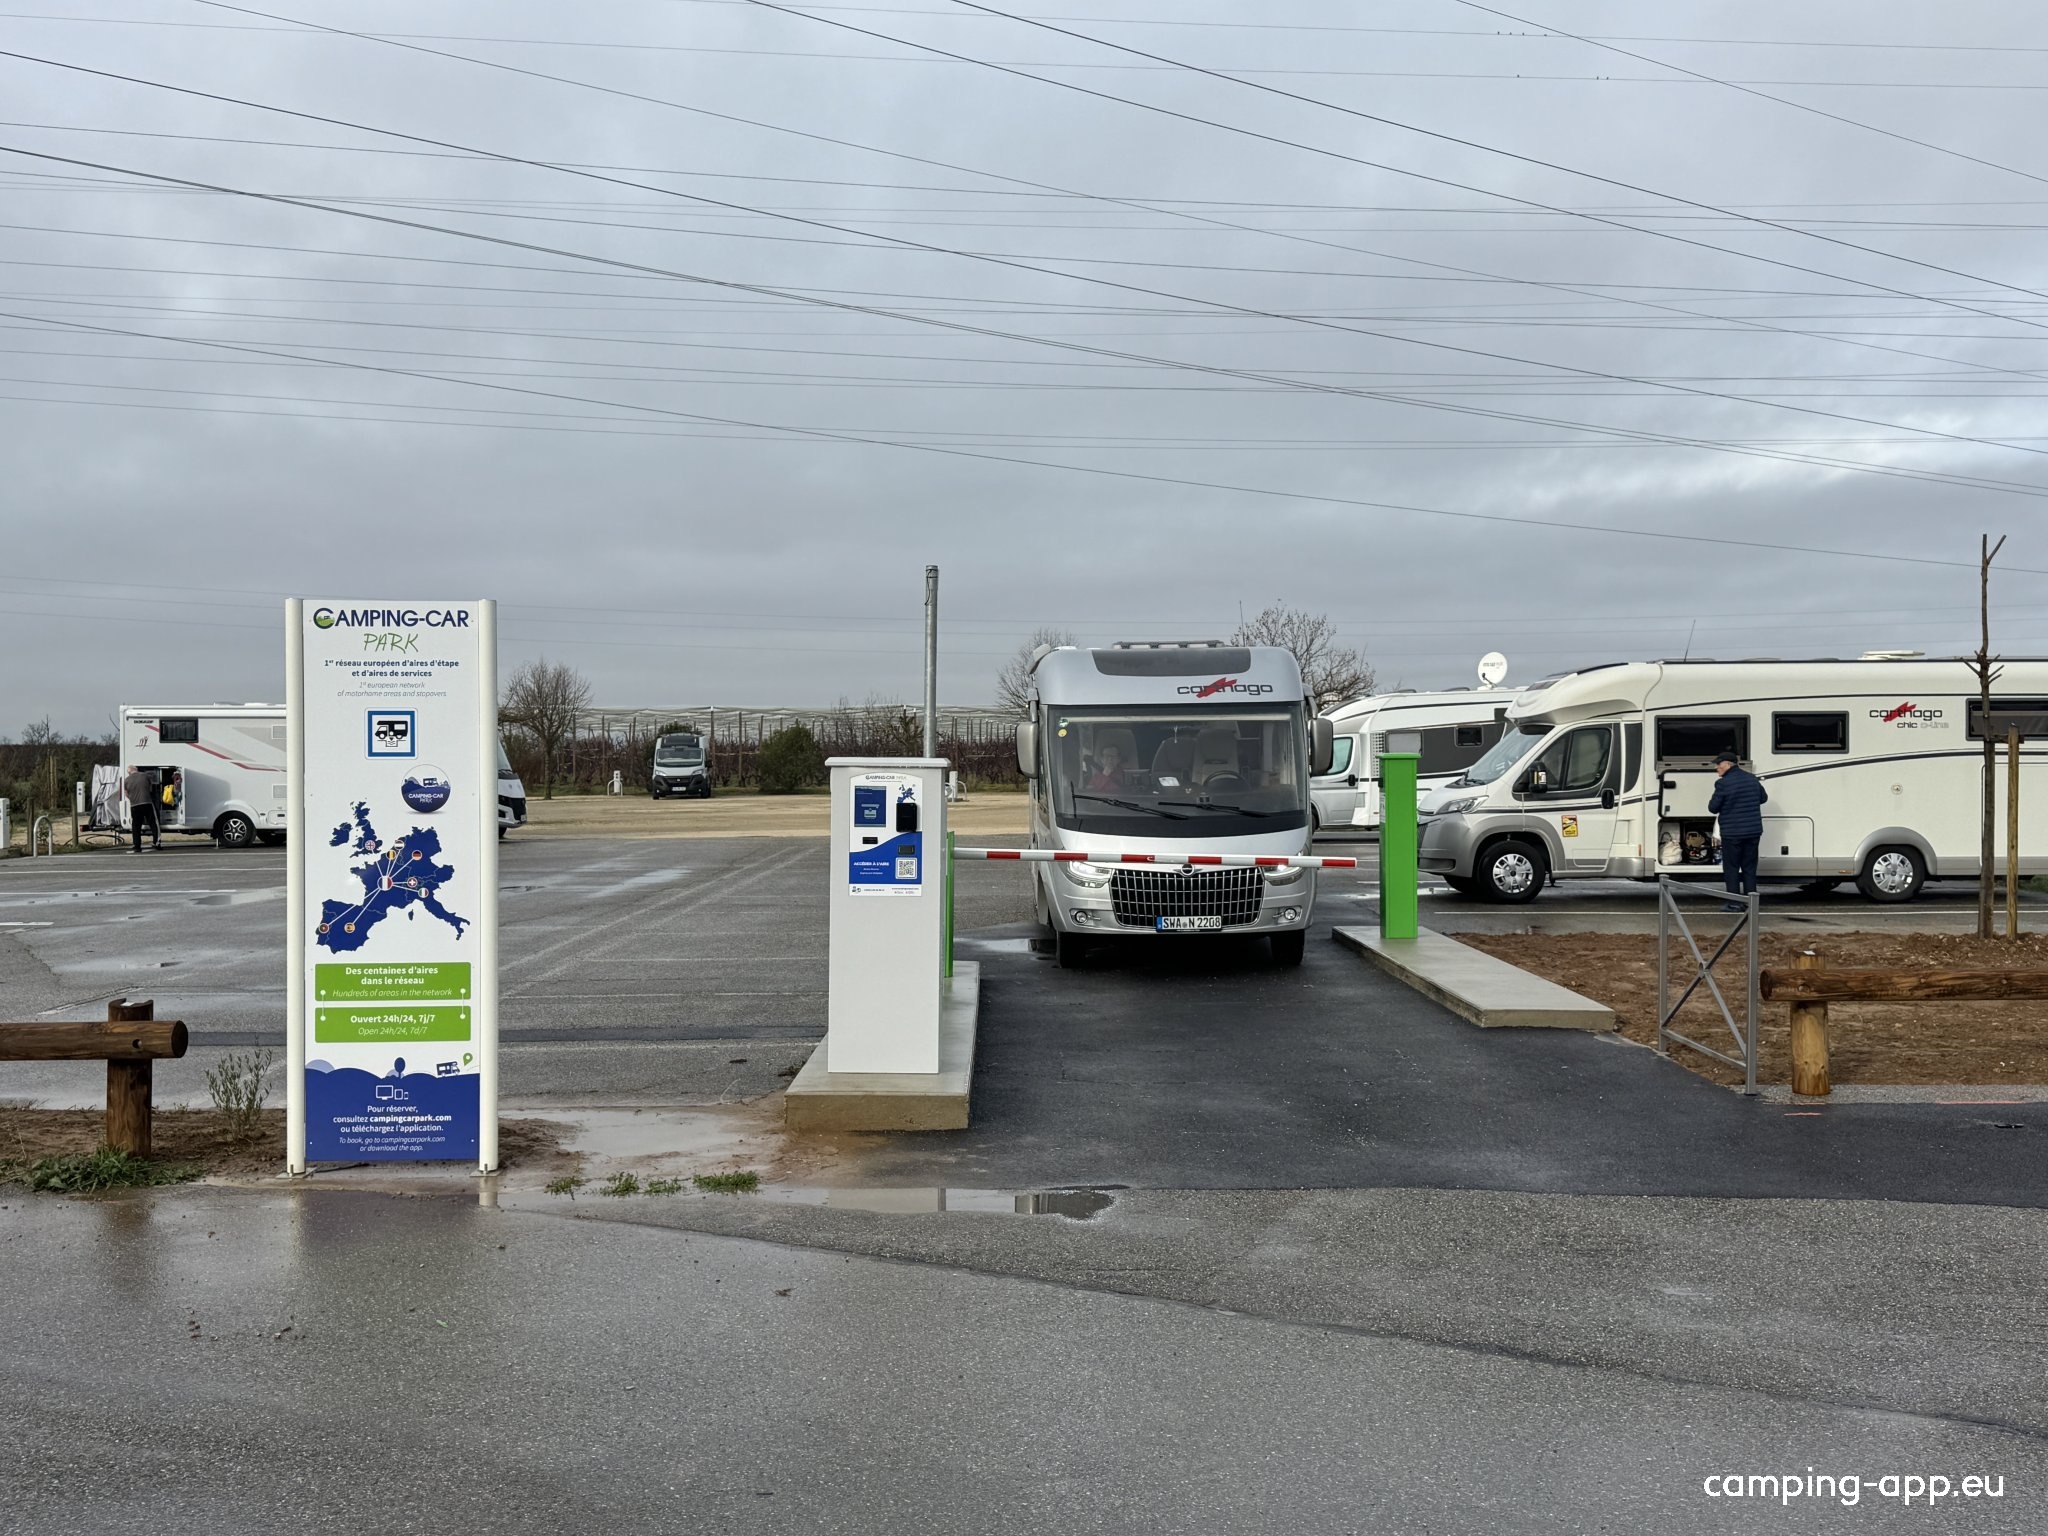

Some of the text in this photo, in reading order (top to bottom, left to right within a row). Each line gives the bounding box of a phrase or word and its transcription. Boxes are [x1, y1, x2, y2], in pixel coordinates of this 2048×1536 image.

[313, 607, 469, 629] CAMPING-CAR
[363, 632, 419, 654] PARK
[335, 659, 361, 667] réseau
[363, 659, 400, 668] européen
[402, 659, 428, 667] d'aires
[430, 659, 459, 668] d'étape
[361, 669, 387, 677] d'aires
[389, 669, 399, 677] de
[400, 669, 432, 677] services
[367, 682, 398, 690] european
[337, 690, 344, 698] of
[416, 690, 447, 698] stopovers
[1897, 721, 1918, 729] chic
[1163, 916, 1221, 928] SWA N 2208
[345, 965, 438, 975] Des centaines d'aires
[361, 976, 425, 985] dans le réseau
[332, 989, 369, 997] Hundreds
[369, 988, 379, 998] of
[400, 988, 408, 996] in
[409, 988, 420, 996] the
[422, 987, 453, 996] network
[350, 1014, 436, 1024] Ouvert 24h/24, 7j/7
[358, 1026, 428, 1036] Open 24h/24, 7d/7
[367, 1104, 418, 1113] Pour réserver,
[333, 1113, 452, 1124] consultez campingcarpark.com
[351, 1124, 394, 1134] téléchargez
[396, 1123, 444, 1134] l'application.
[339, 1136, 347, 1144] To
[347, 1136, 364, 1144] book,
[364, 1138, 373, 1146] go
[381, 1135, 446, 1145] campingcarpark.com
[367, 1144, 398, 1152] download
[409, 1145, 424, 1153] app.
